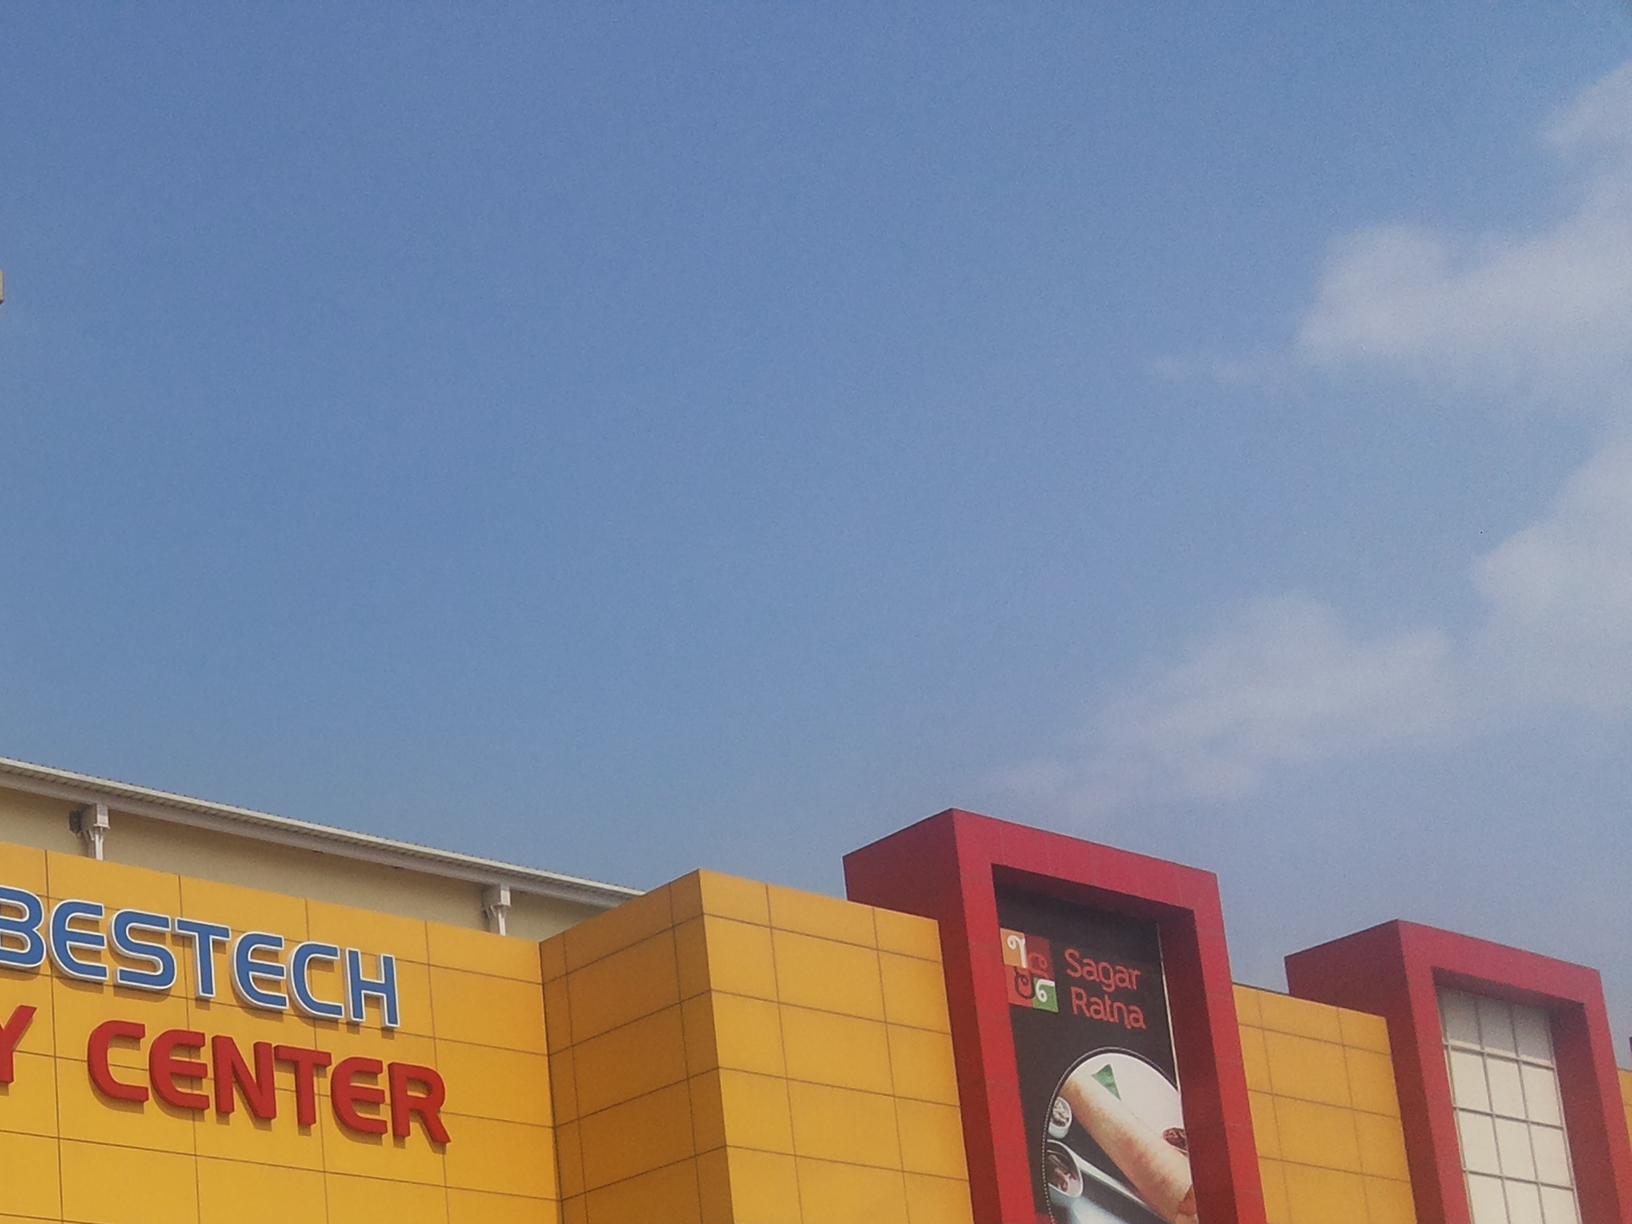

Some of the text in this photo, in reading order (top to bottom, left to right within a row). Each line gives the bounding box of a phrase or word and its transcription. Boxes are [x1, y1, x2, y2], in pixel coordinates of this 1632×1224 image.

[1064, 948, 1142, 993] Sagar
[1070, 986, 1147, 1031] Ratna
[87, 1019, 452, 1146] CENTER
